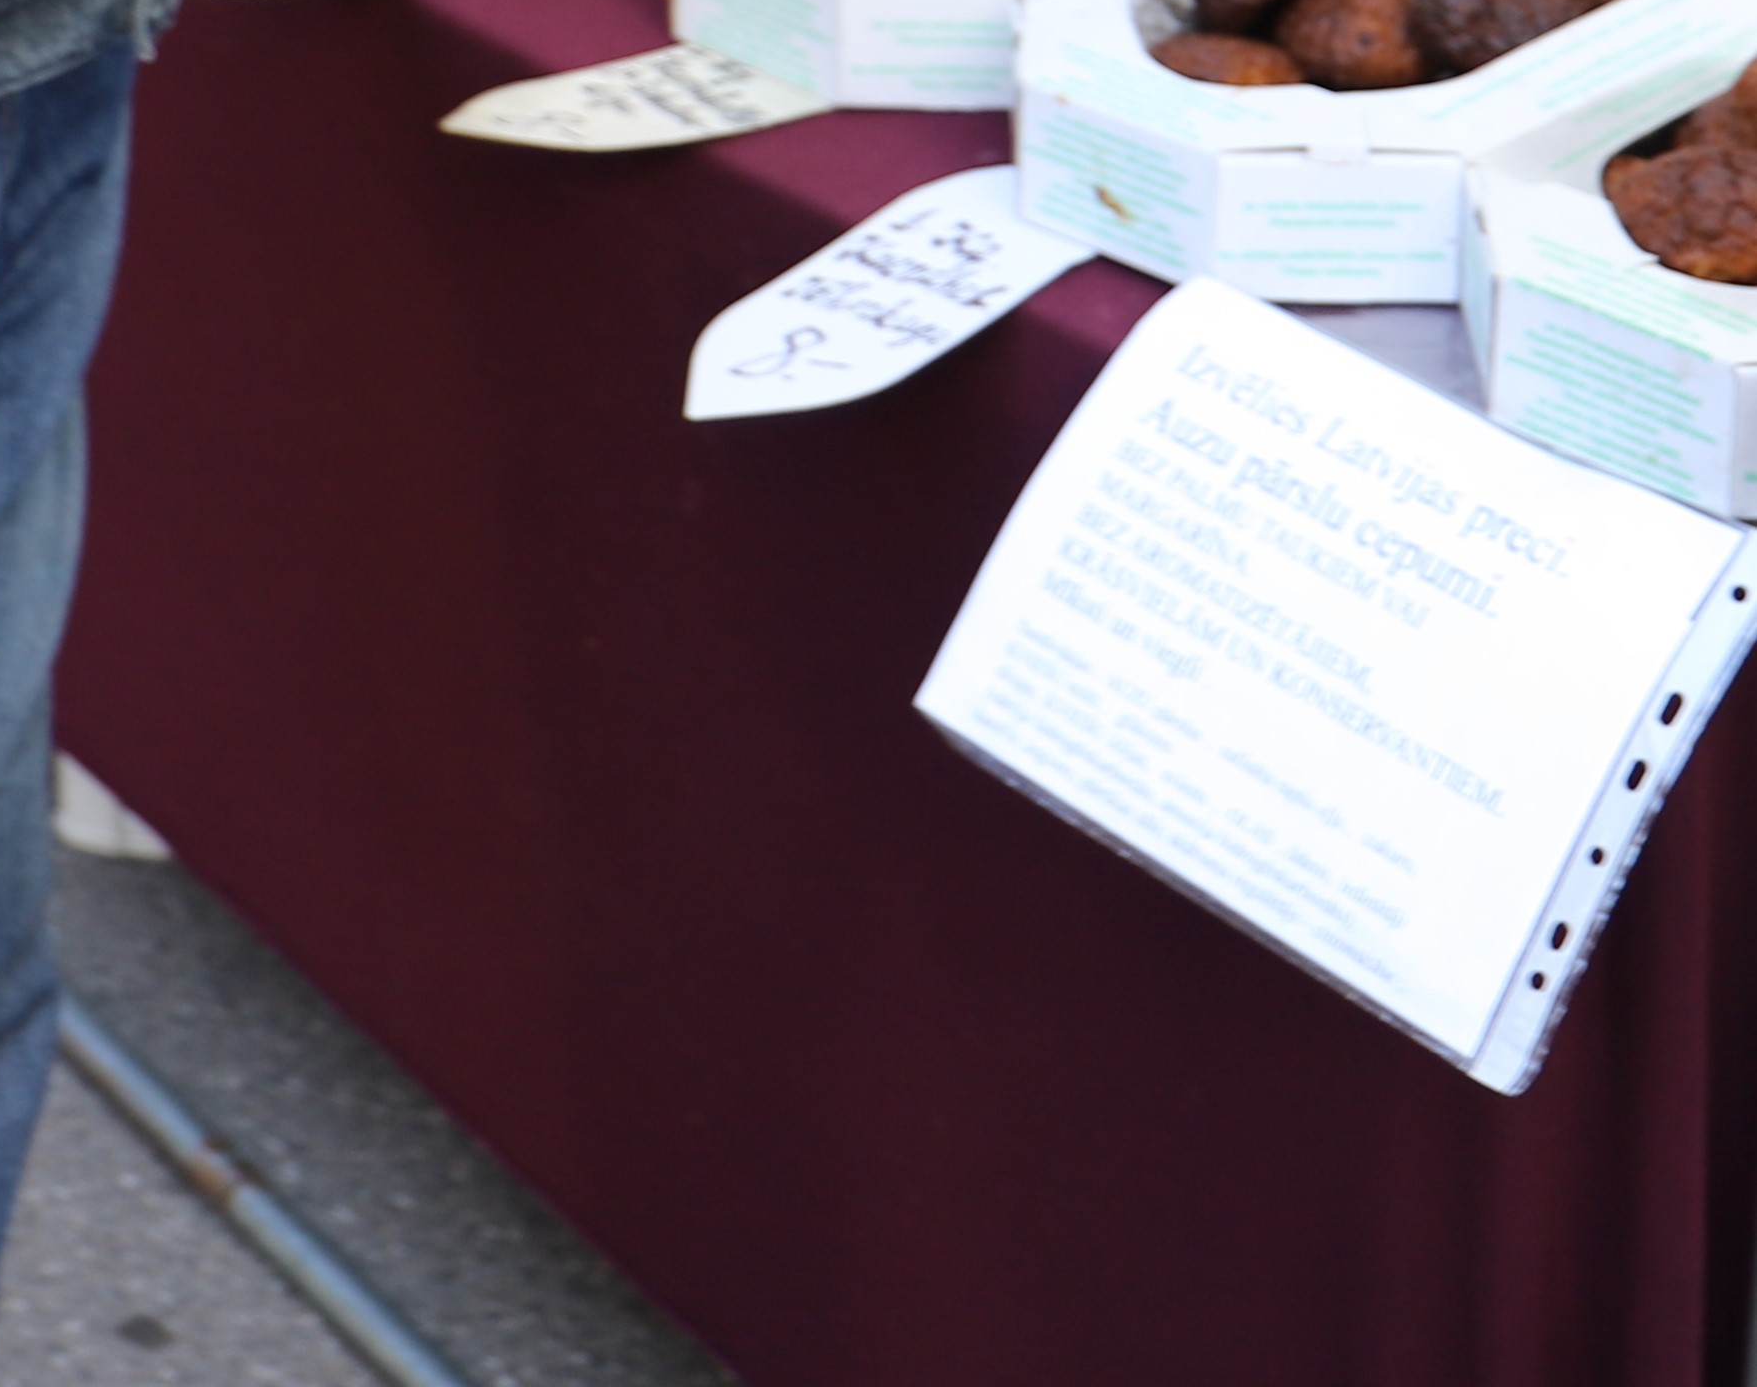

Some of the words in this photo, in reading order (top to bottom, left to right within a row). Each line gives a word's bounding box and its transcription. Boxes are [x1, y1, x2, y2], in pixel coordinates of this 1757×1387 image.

[1138, 397, 1237, 468] Auzu
[1228, 453, 1352, 533] pārslu
[1352, 519, 1503, 619] cepumi.
[1314, 416, 1462, 516] Latvijas
[1457, 503, 1575, 578] preci.
